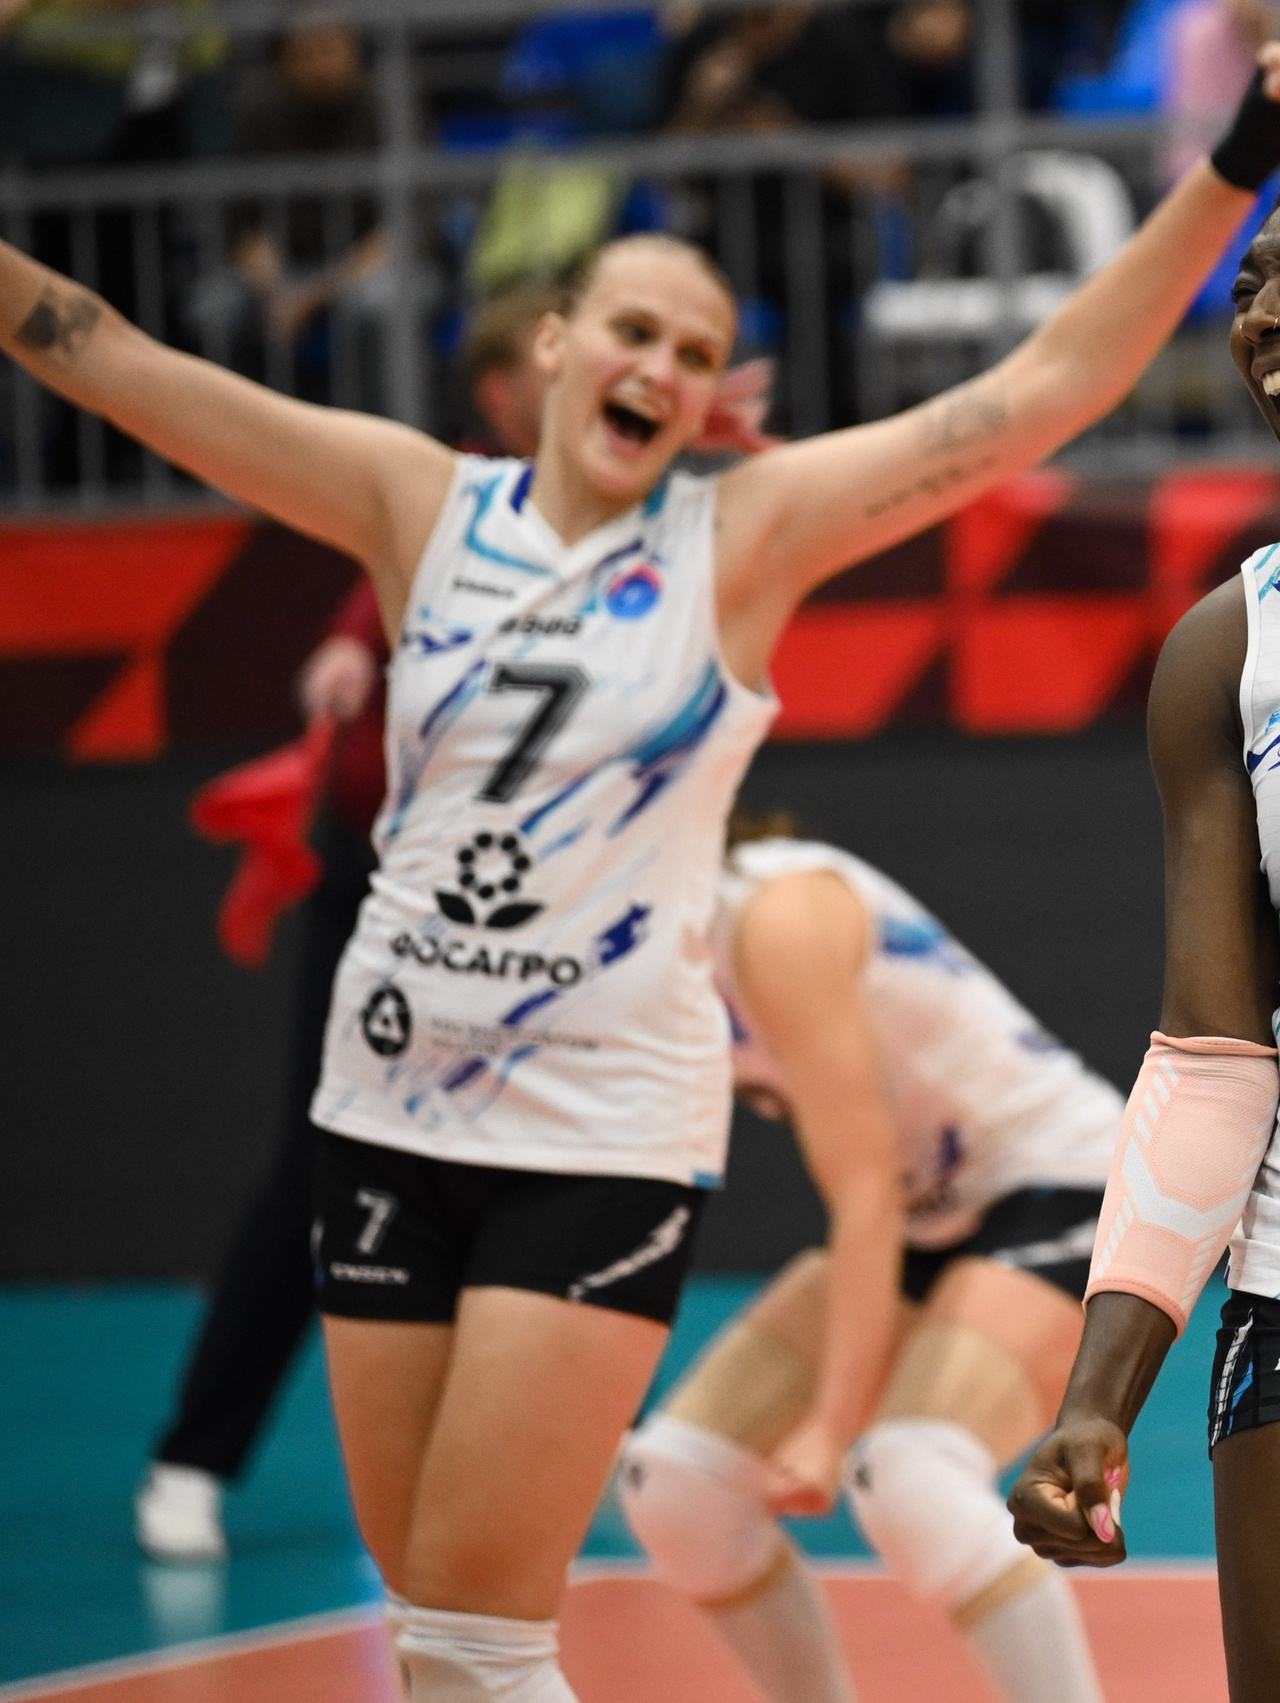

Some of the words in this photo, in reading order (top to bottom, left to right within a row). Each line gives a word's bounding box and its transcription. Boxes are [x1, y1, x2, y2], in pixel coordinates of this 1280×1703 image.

[477, 660, 590, 803] 7
[389, 932, 583, 988] ФОСАГРО
[356, 1190, 398, 1254] 7
